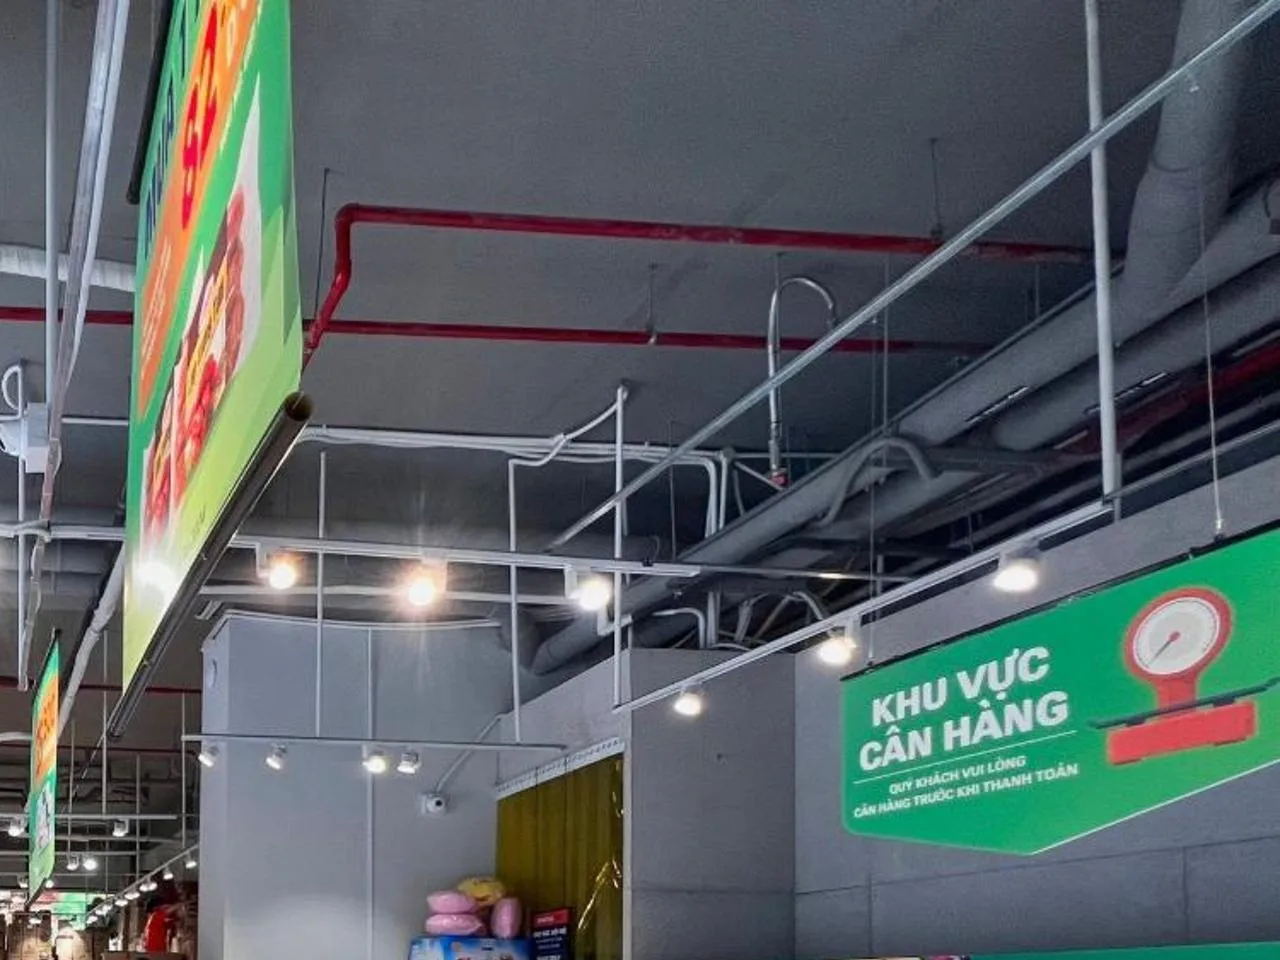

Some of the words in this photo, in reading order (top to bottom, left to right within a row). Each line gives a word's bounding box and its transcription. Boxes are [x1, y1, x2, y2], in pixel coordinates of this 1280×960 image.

[871, 676, 948, 727] KHU
[956, 646, 1051, 701] VỰC
[859, 724, 933, 771] CÂN
[943, 691, 1069, 751] HÀNG
[878, 797, 911, 814] HÀNG
[956, 785, 980, 799] KHI
[982, 774, 1033, 793] THANH
[1035, 761, 1080, 782] TOÁN
[915, 769, 960, 789] KHÁCH
[962, 765, 985, 779] VUI
[987, 755, 1027, 772] LÒNG
